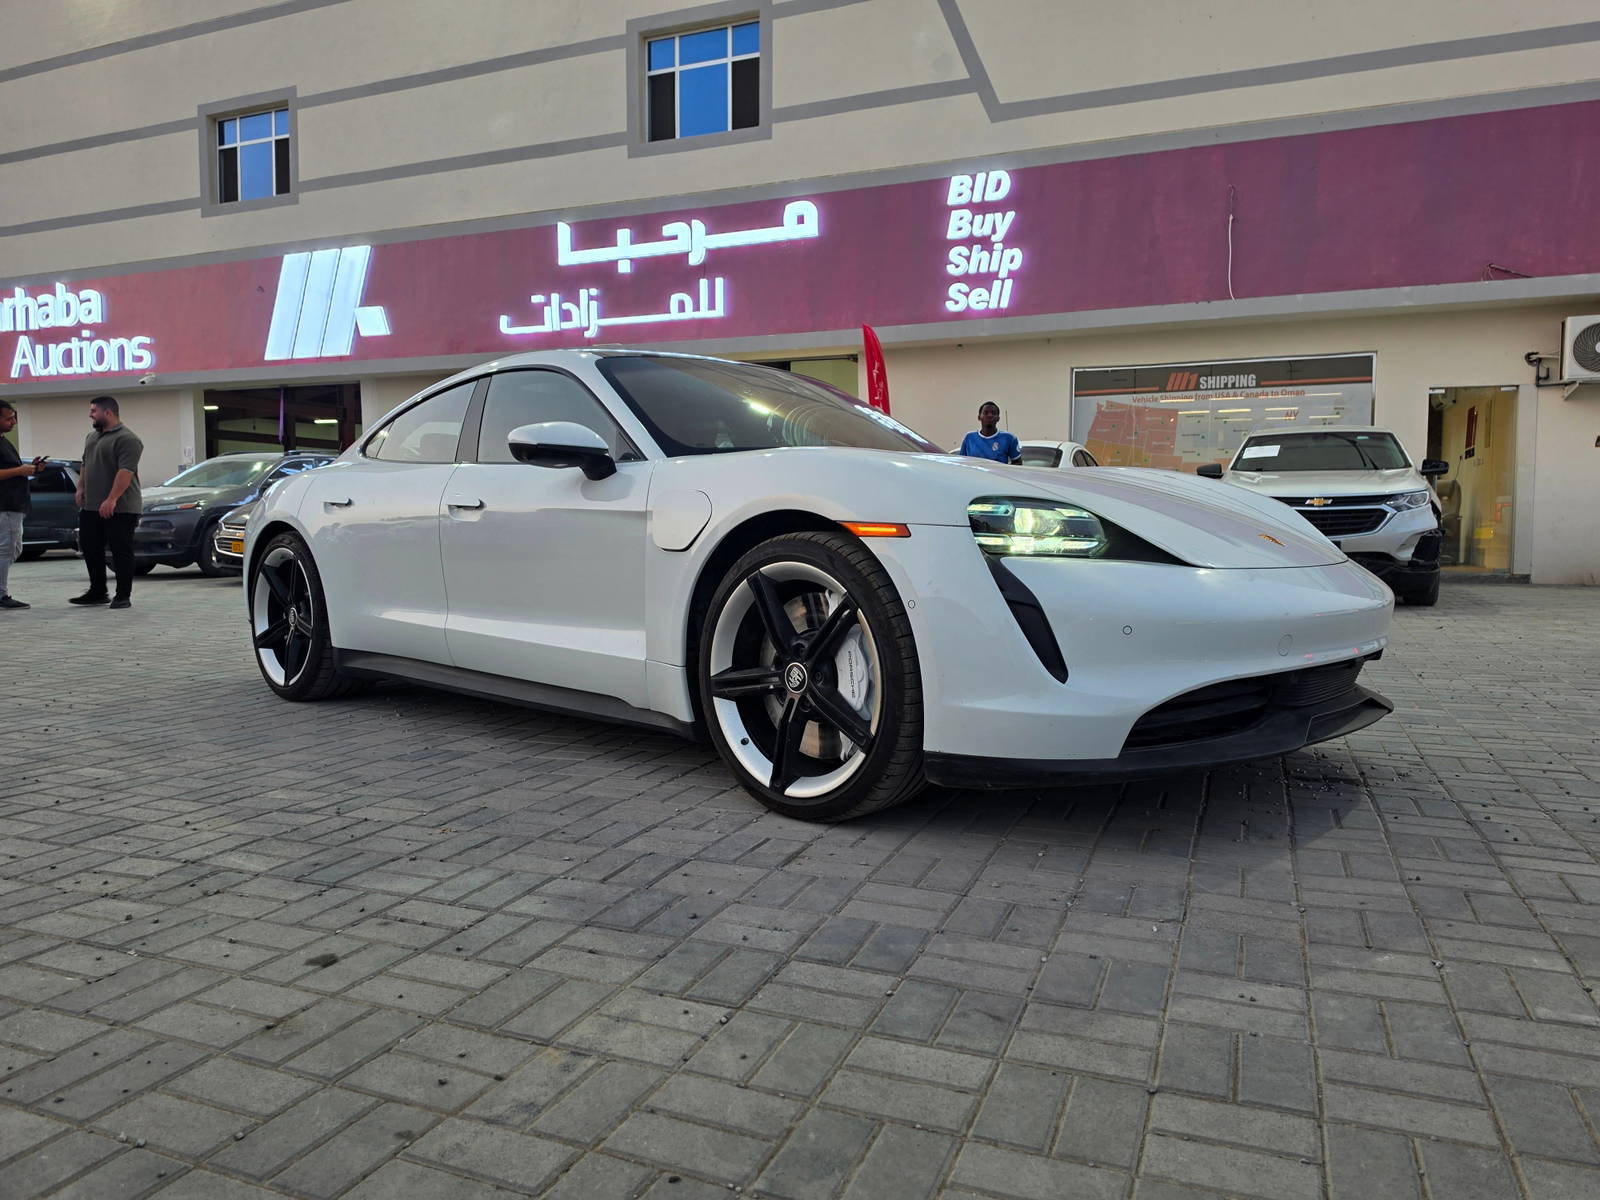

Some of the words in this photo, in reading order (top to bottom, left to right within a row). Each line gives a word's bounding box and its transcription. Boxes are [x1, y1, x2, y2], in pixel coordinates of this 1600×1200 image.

[947, 170, 1011, 206] BID
[557, 200, 818, 273] مرحبا
[946, 209, 1016, 242] Buy
[946, 243, 1023, 279] Ship
[0, 282, 103, 332] rhaba
[499, 277, 724, 338] للمزادات
[945, 279, 1013, 312] Sell
[10, 329, 152, 379] Auctions
[1132, 394, 1159, 403] Vehicle
[1195, 389, 1214, 401] from
[1215, 390, 1230, 399] USA
[1240, 388, 1269, 398] Canada
[1271, 388, 1280, 397] to
[1281, 387, 1306, 397] Oman
[1199, 373, 1257, 390] SHIPPING
